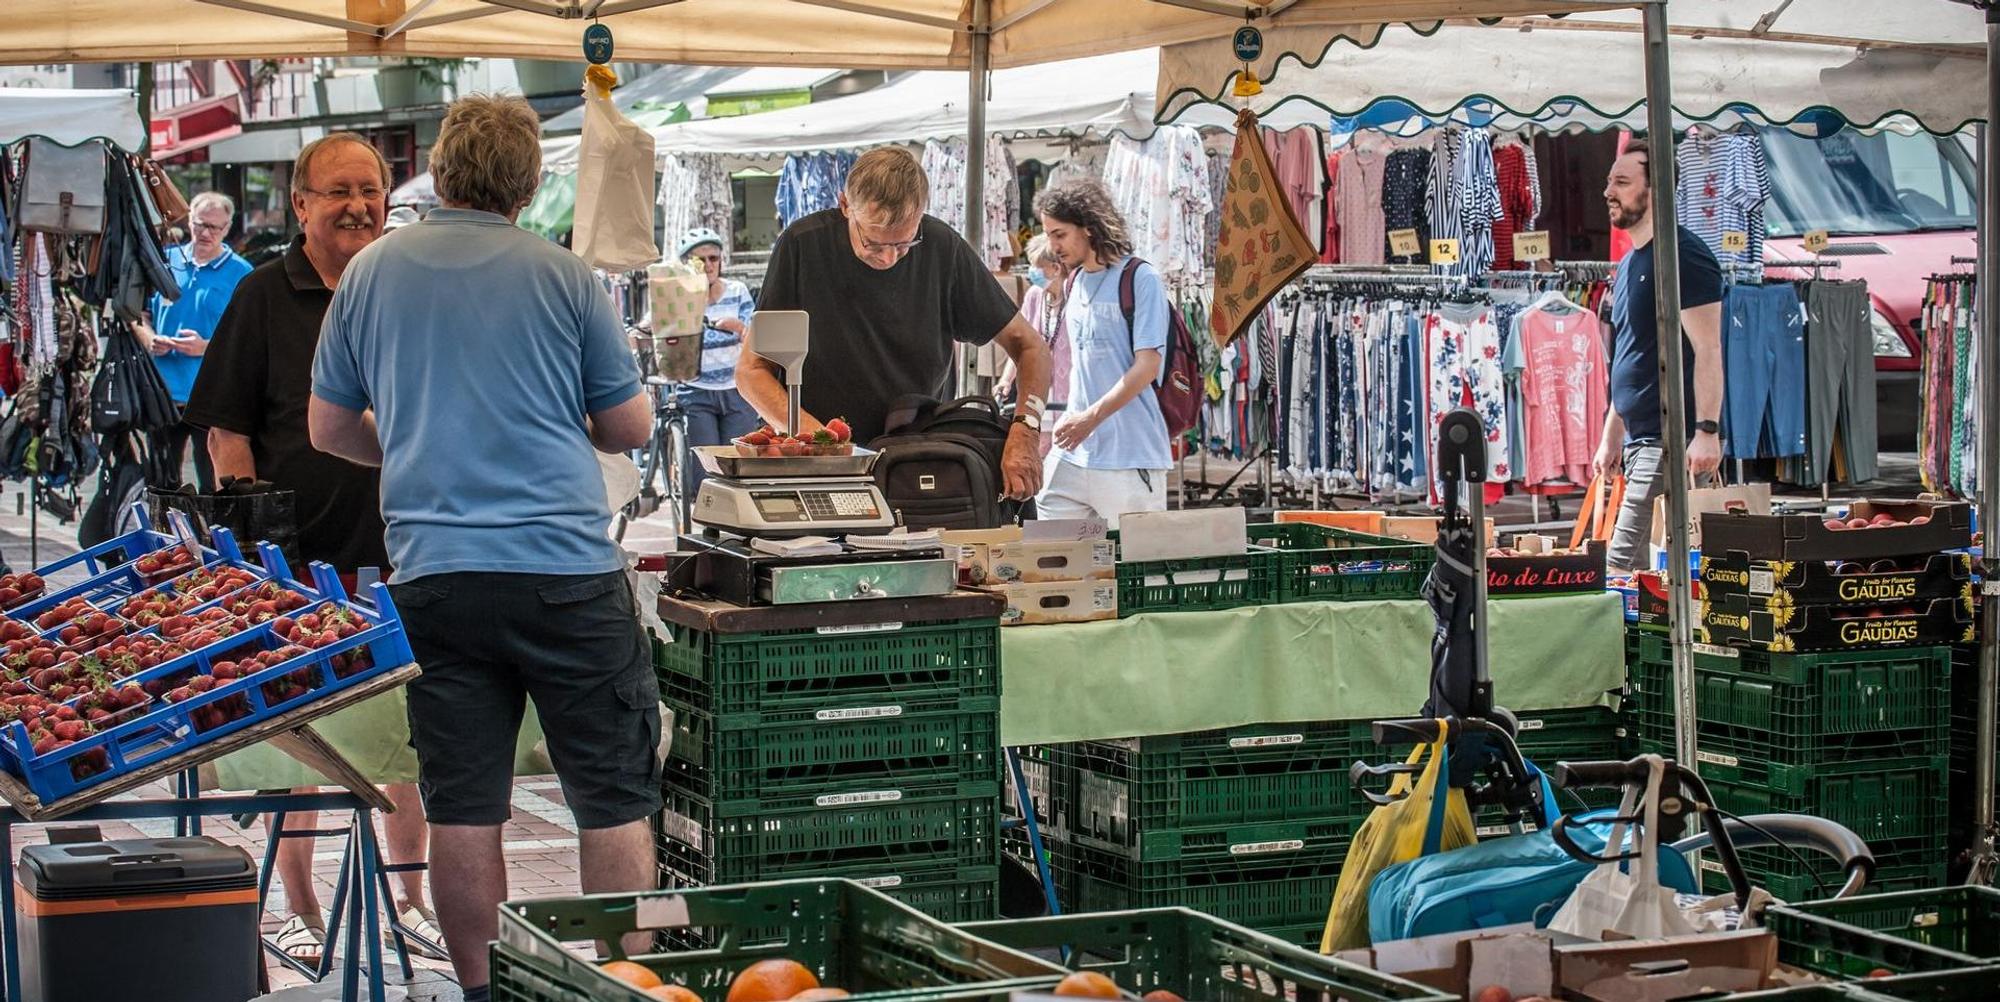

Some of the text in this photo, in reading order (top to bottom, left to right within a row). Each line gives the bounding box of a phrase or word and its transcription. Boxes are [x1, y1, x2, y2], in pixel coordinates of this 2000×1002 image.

[1514, 565, 1541, 586] de
[1543, 566, 1599, 586] Luxe
[1839, 578, 1916, 601] GAUDIAS
[1841, 621, 1918, 643] GAUDIAS
